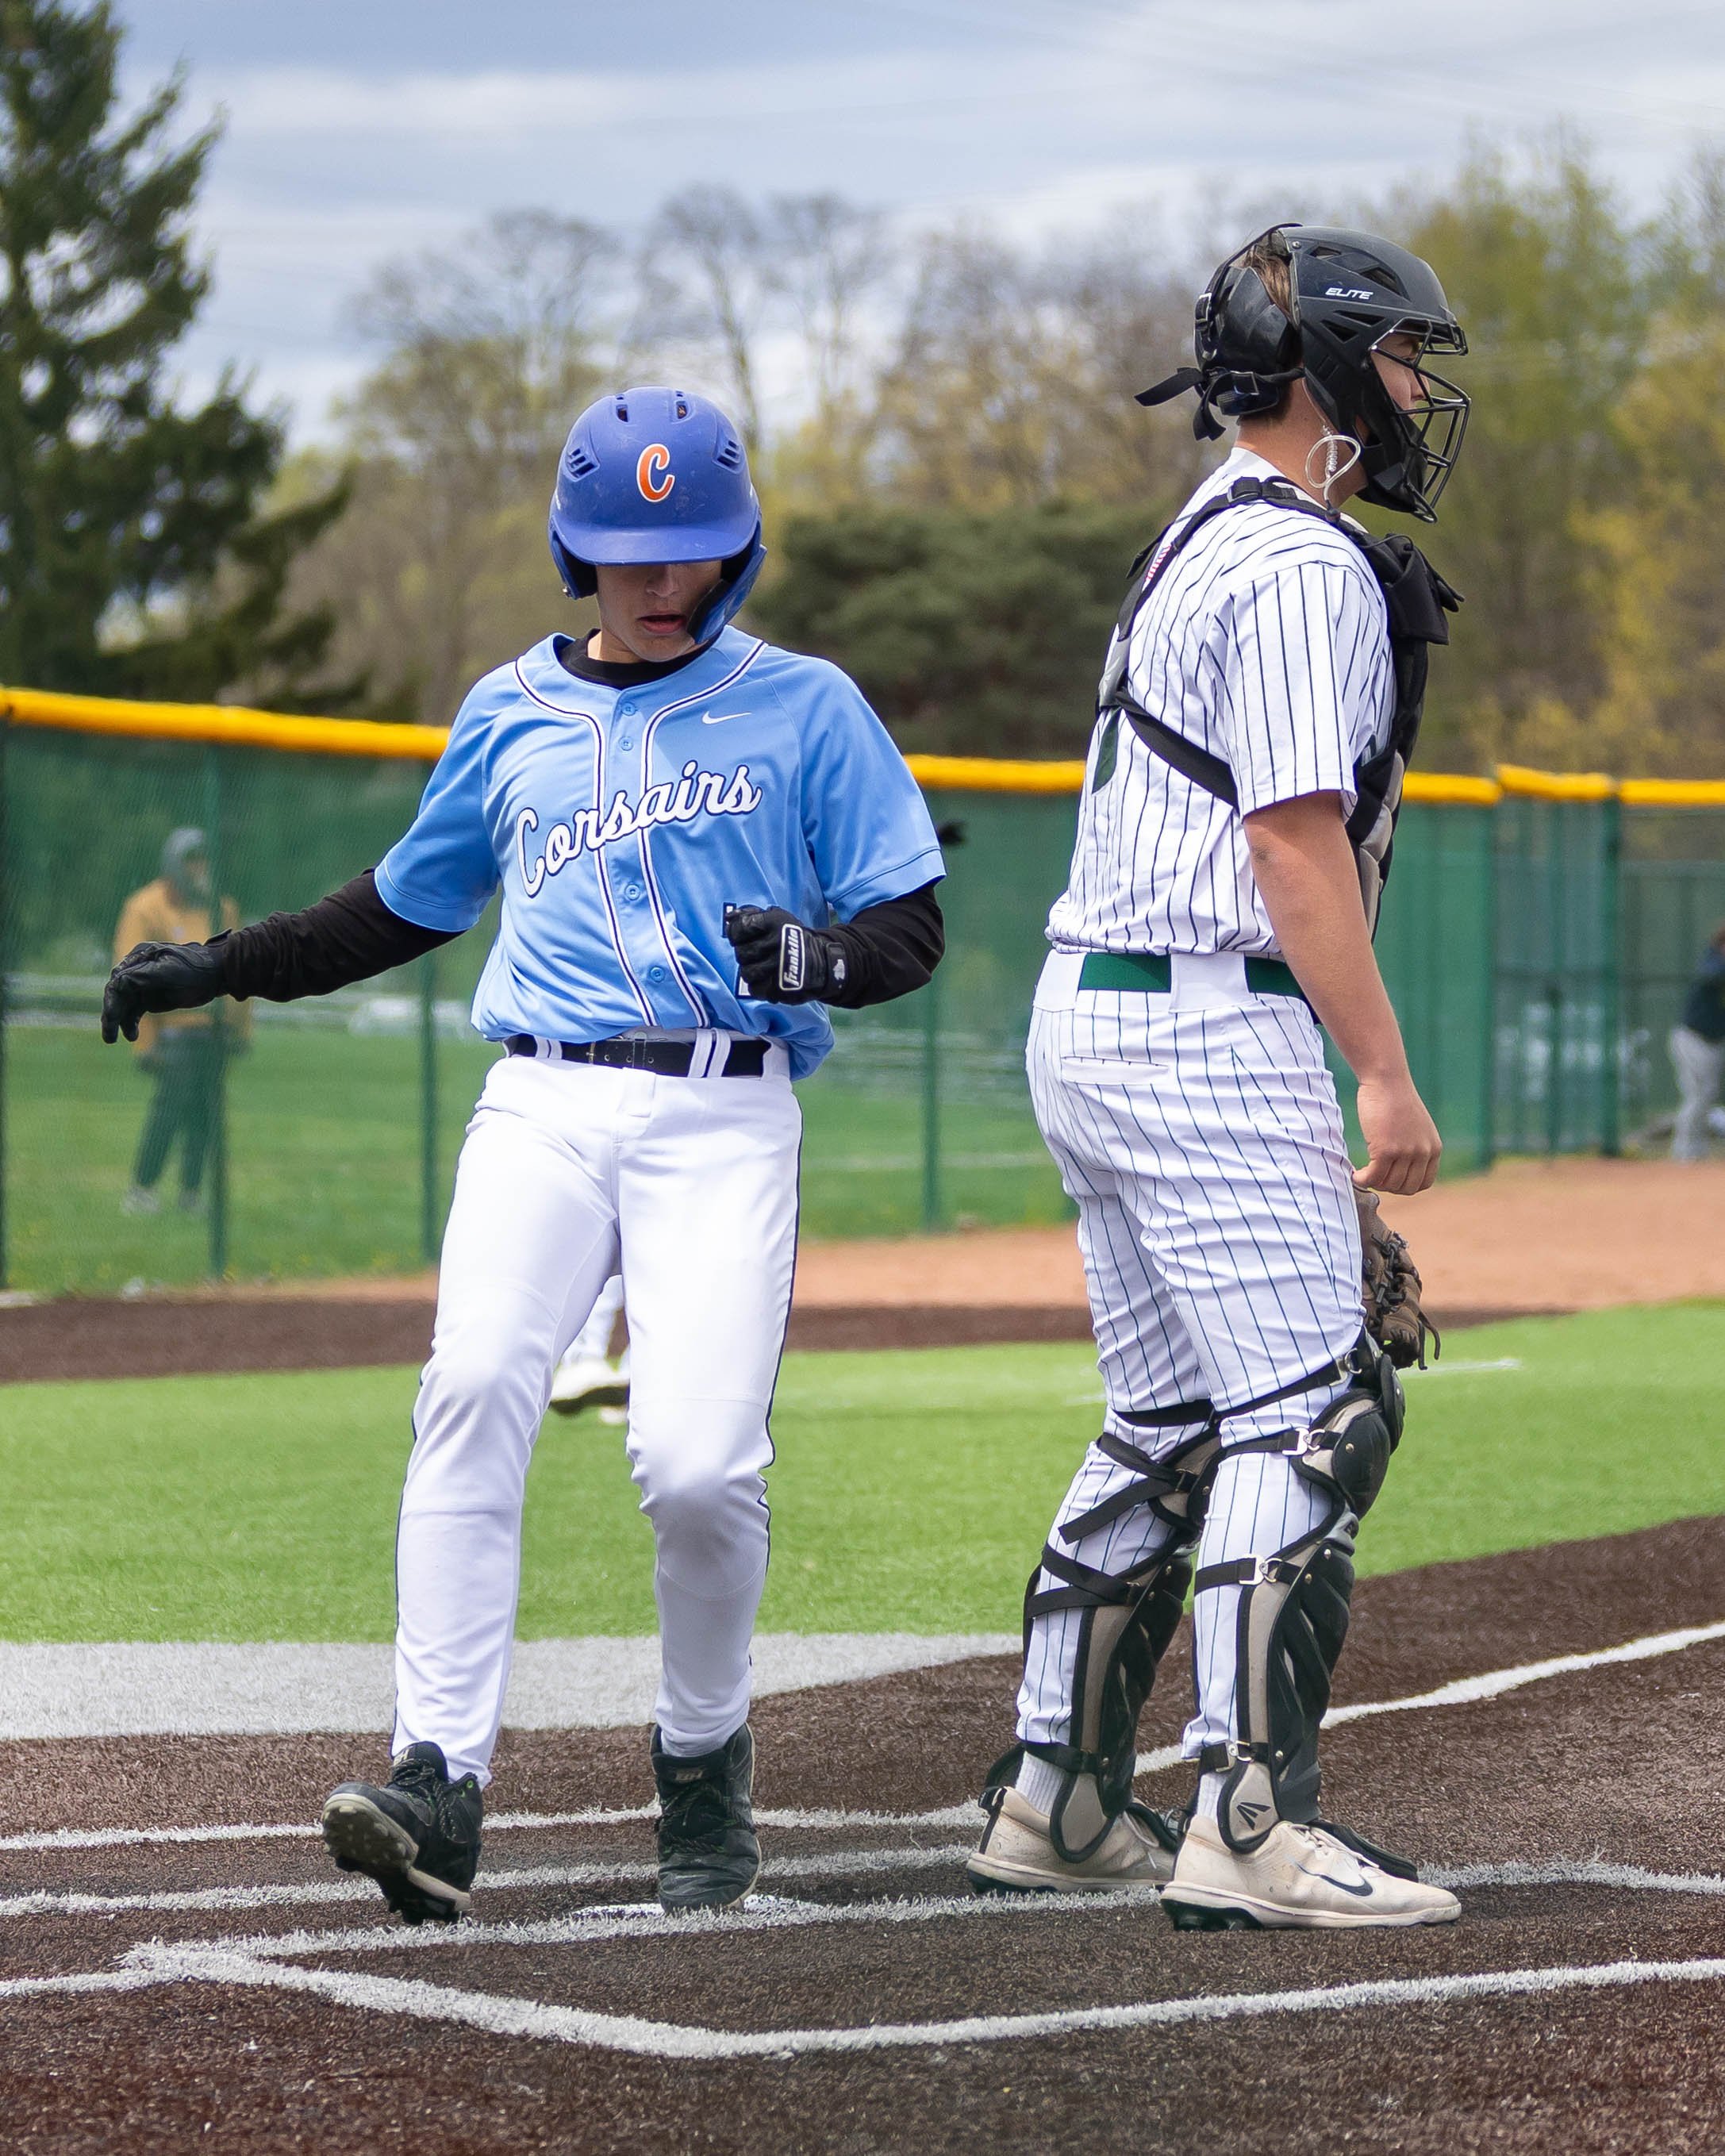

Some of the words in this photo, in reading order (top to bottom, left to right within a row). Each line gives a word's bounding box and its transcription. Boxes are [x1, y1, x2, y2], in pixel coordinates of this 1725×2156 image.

[1325, 287, 1373, 299] ELITE
[636, 443, 674, 502] C
[517, 759, 762, 898] Corsairs
